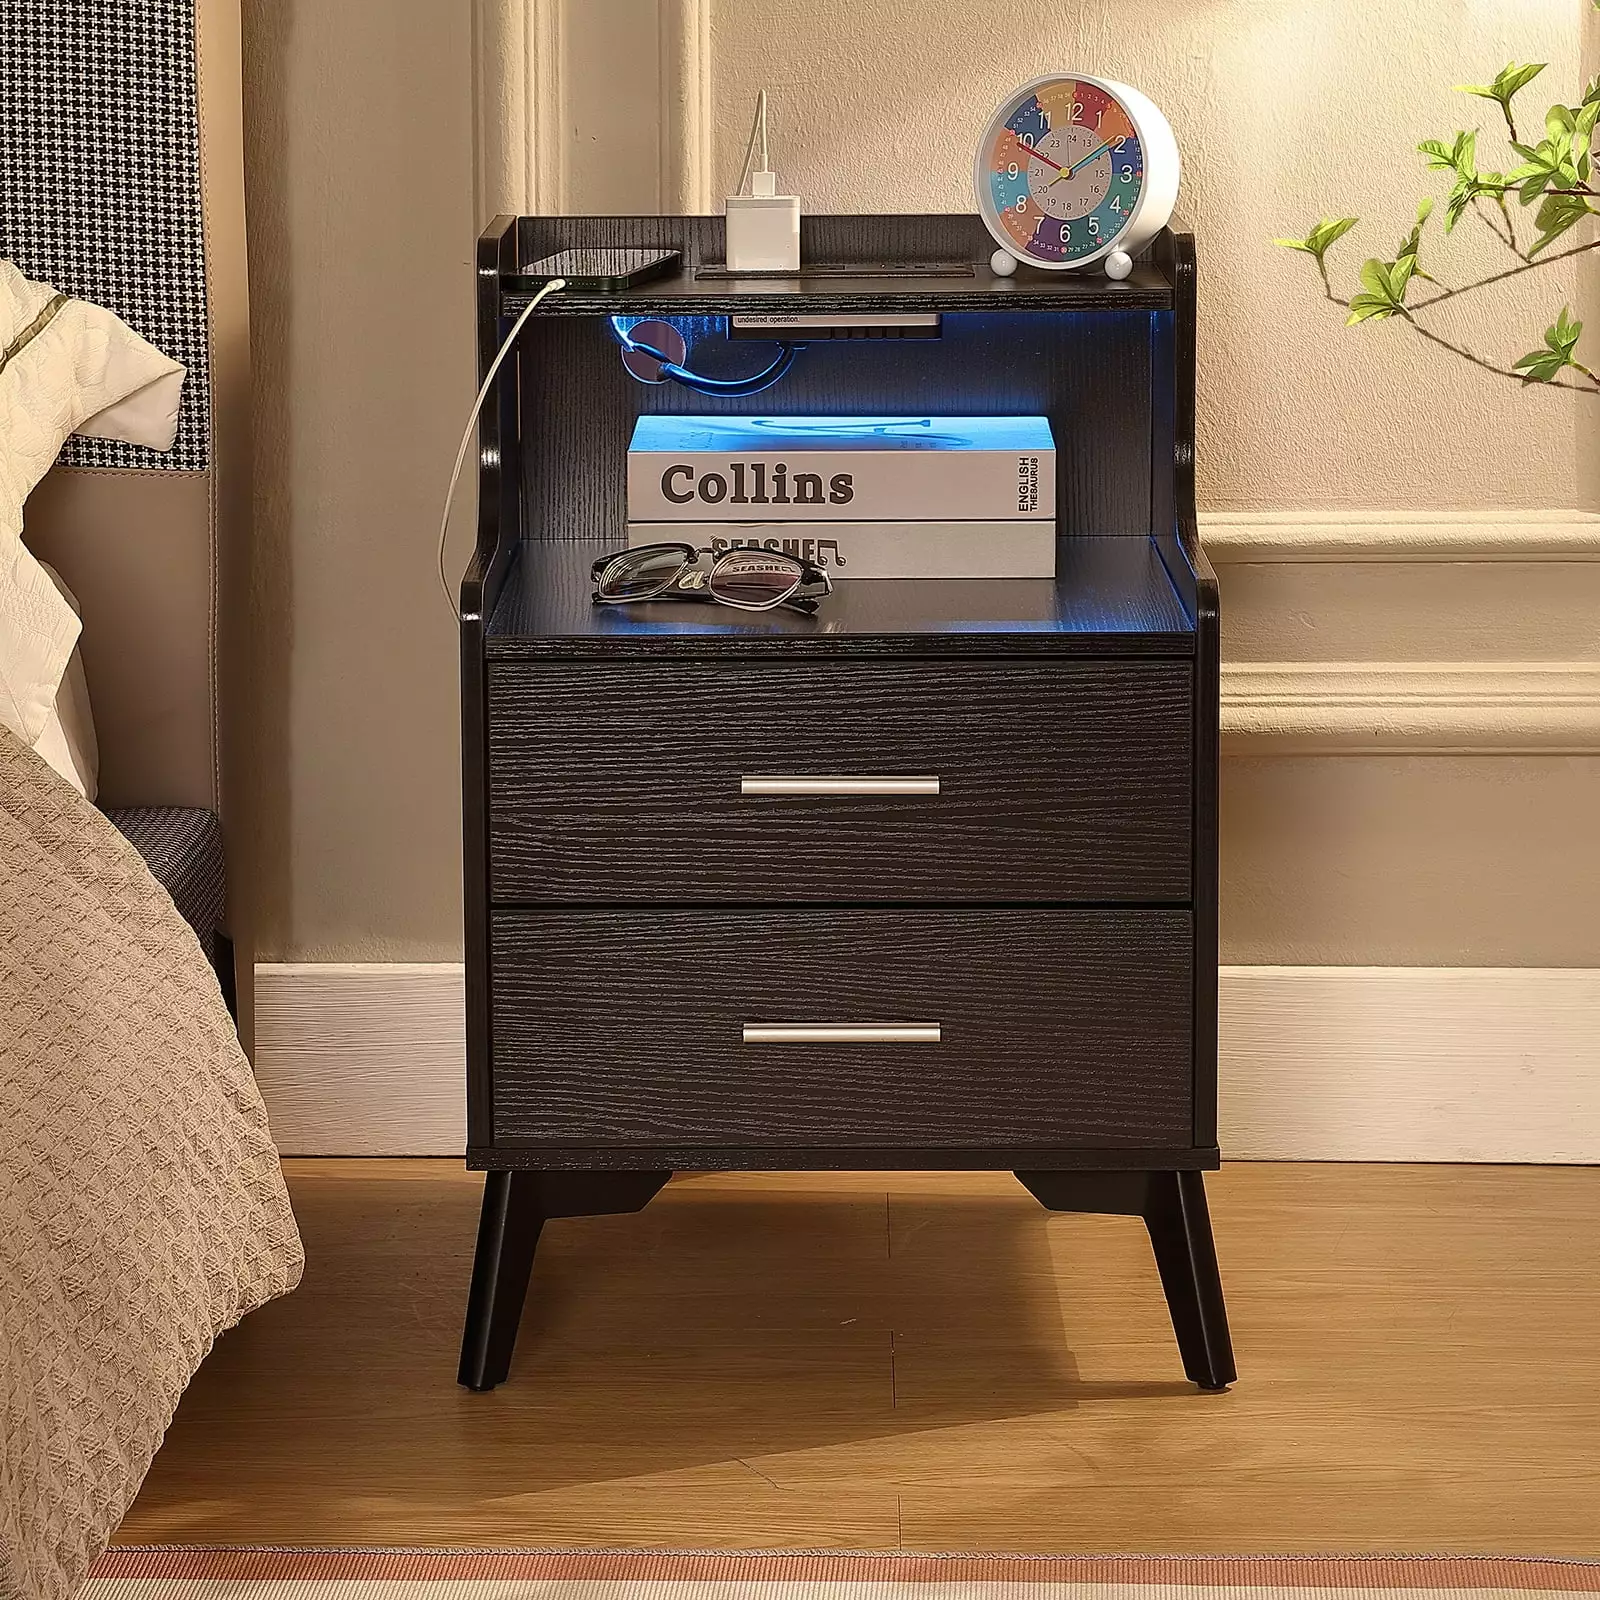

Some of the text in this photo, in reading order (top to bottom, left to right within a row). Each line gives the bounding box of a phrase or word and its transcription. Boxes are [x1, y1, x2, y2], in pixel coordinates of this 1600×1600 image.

[1038, 111, 1051, 129] 11
[1065, 103, 1083, 120] 12
[1096, 111, 1102, 128] 1
[1017, 133, 1034, 151] 10
[1114, 136, 1126, 153] 2
[1008, 162, 1018, 180] 9
[1120, 165, 1132, 183] 3
[1016, 195, 1026, 212] 8
[1110, 195, 1121, 213] 4
[1034, 217, 1045, 234] 7
[1060, 225, 1070, 242] 6
[1088, 217, 1099, 234] 5
[661, 463, 854, 504] Collins
[1018, 457, 1029, 512] ENGLISH
[1030, 457, 1038, 512] THESAURUS
